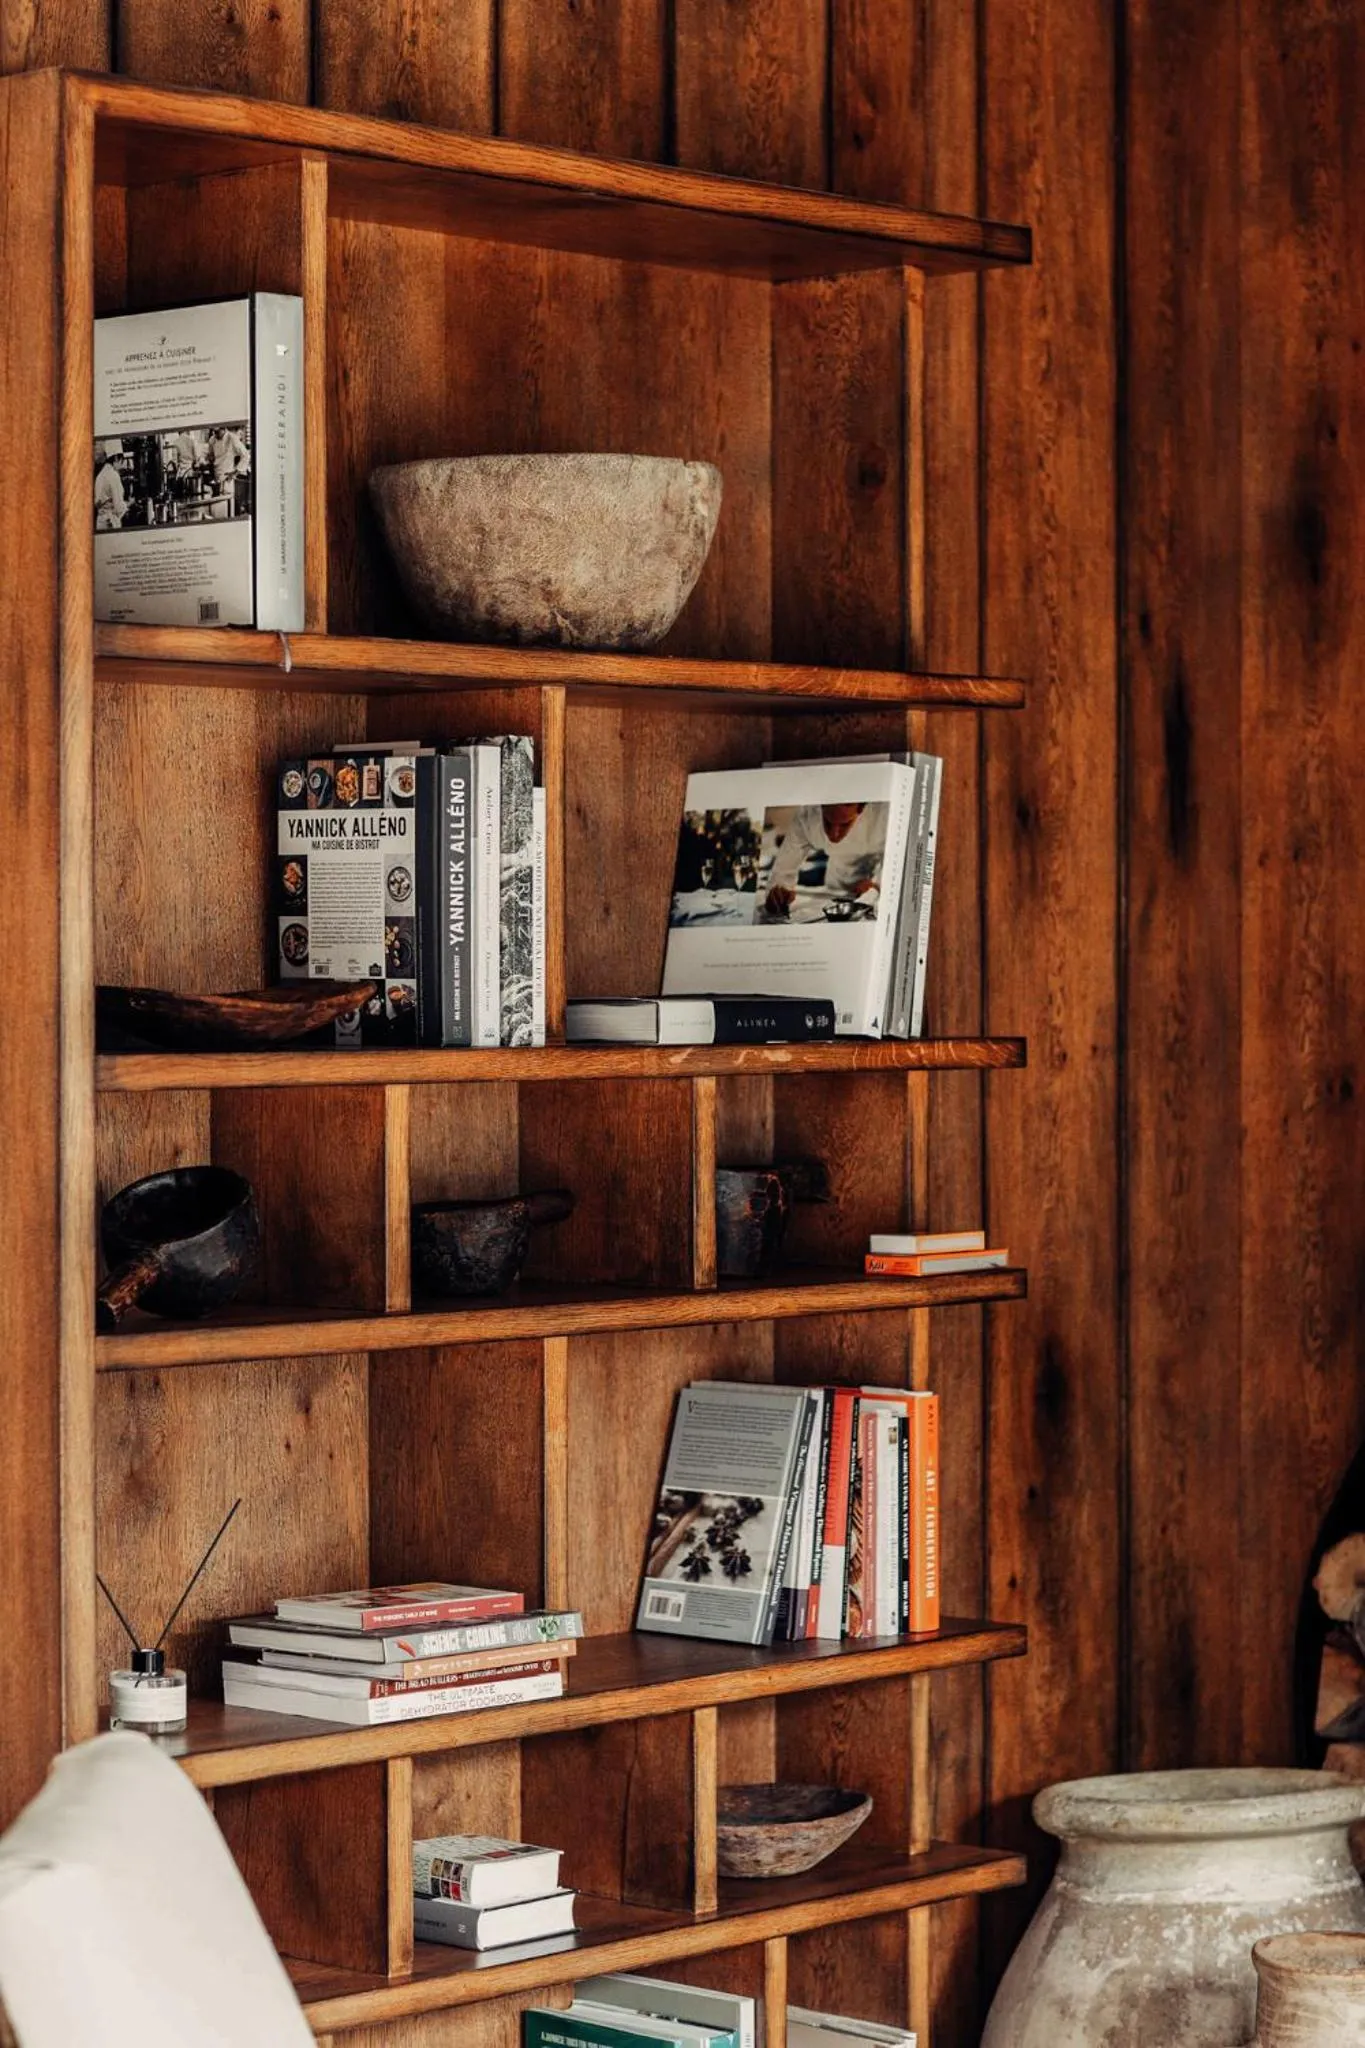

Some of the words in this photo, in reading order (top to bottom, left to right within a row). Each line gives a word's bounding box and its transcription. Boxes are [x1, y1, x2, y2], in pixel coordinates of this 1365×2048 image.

[277, 374, 286, 460] FERRANDI
[287, 818, 347, 838] YANNICK
[352, 812, 407, 837] ALLÉNO
[446, 778, 465, 854] ALLÉNO
[311, 840, 321, 850] MA
[322, 840, 344, 850] CUISINE
[346, 840, 353, 850] DE
[355, 839, 379, 850] BISTROT
[449, 860, 465, 946] YANNICK
[736, 1019, 777, 1028] ALINEA
[926, 1470, 936, 1492] ART
[925, 1506, 936, 1599] FERMENTATION
[395, 1681, 407, 1691] THE
[428, 1691, 446, 1701] THE
[451, 1684, 496, 1700] ULTIMATE
[400, 1700, 466, 1716] DEHYDRATOR
[469, 1692, 523, 1708] COOKBOOK
